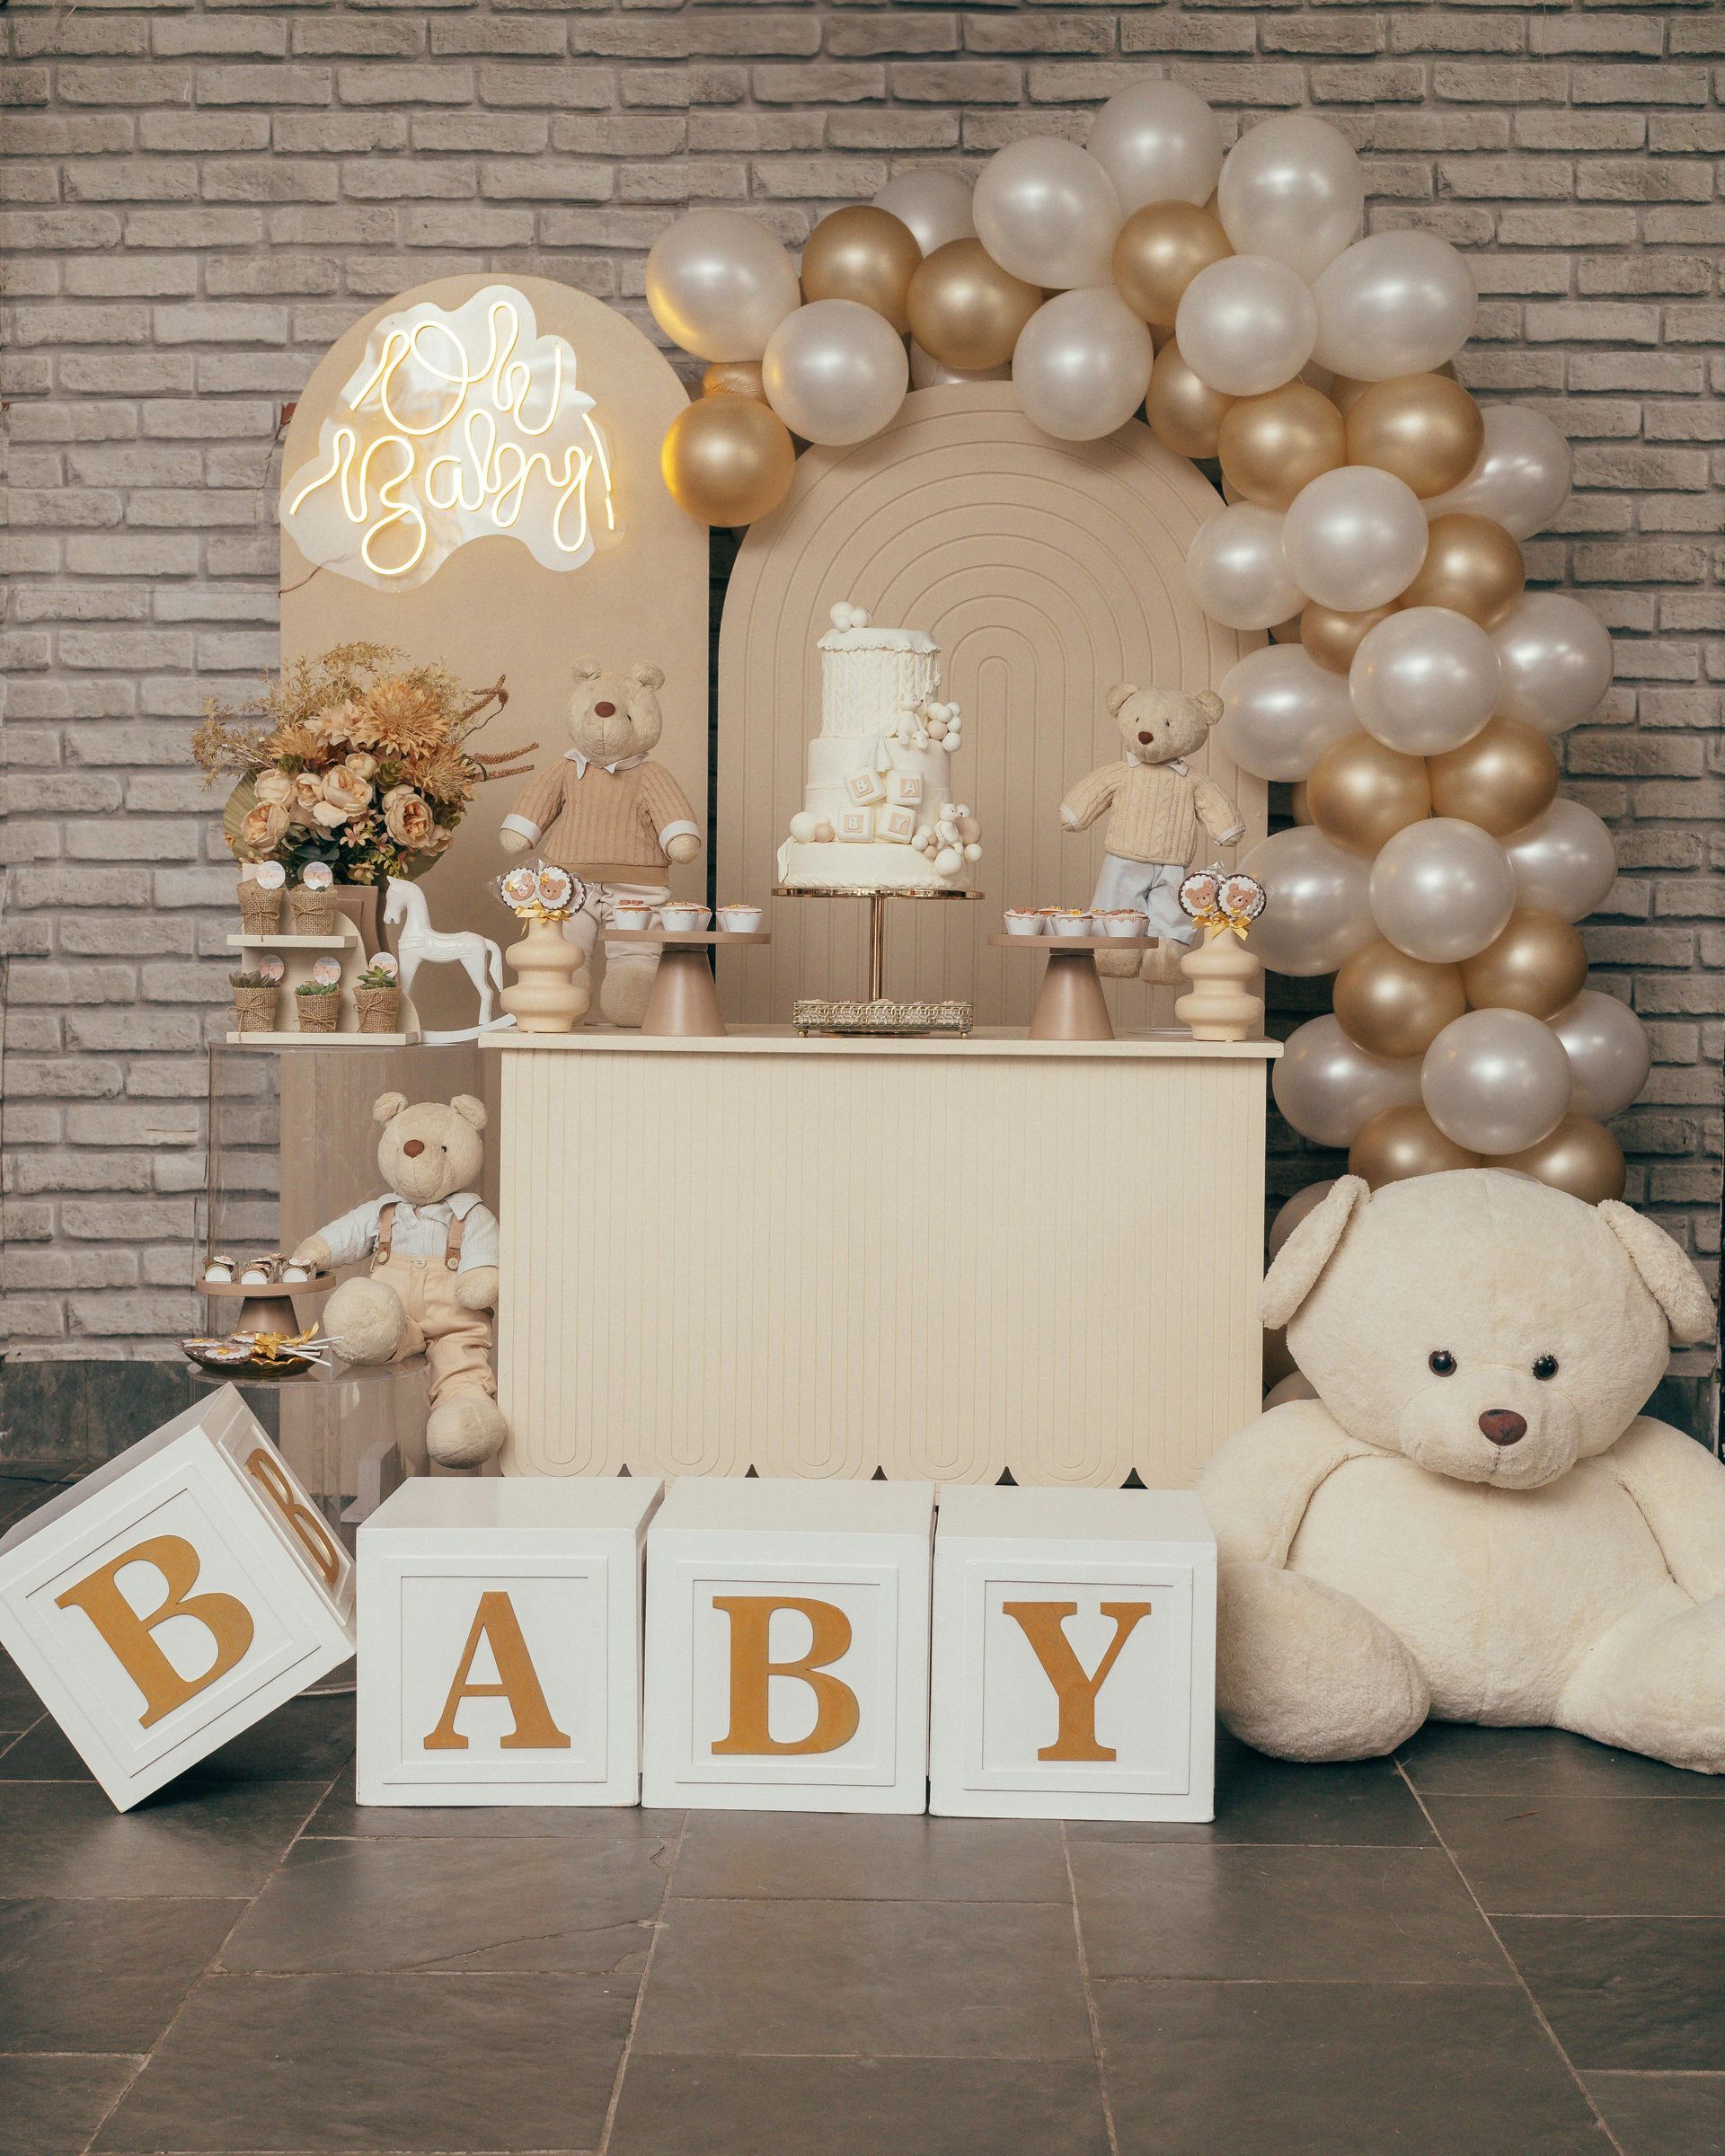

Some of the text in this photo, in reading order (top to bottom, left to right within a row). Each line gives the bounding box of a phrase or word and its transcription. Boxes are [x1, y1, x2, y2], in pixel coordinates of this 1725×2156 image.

[350, 301, 562, 436] Oh
[905, 779, 916, 795] A
[244, 1447, 341, 1590] B
[54, 1534, 255, 1729] B
[422, 1591, 571, 1750] A
[711, 1595, 861, 1756] B
[1002, 1601, 1152, 1762] Y
